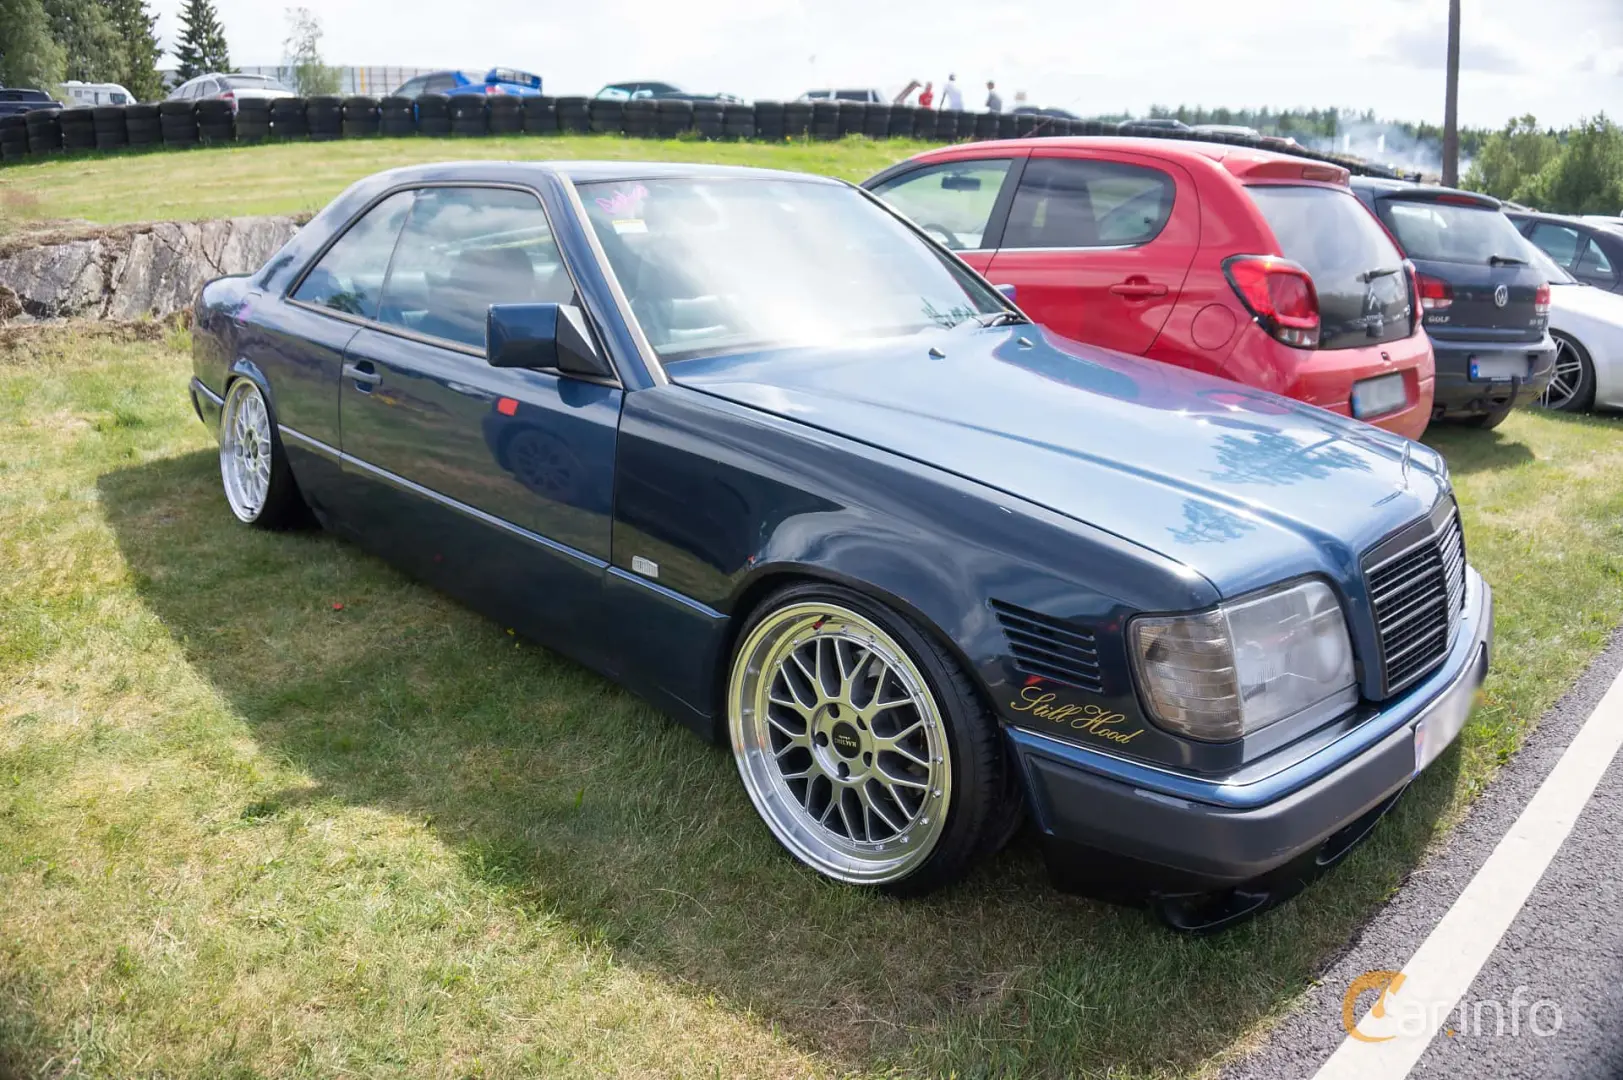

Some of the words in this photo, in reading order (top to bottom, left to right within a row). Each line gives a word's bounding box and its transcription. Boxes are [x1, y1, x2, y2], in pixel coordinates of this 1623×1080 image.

[1428, 315, 1450, 323] GOLF
[1010, 686, 1082, 723] Still
[1070, 705, 1144, 744] Hood
